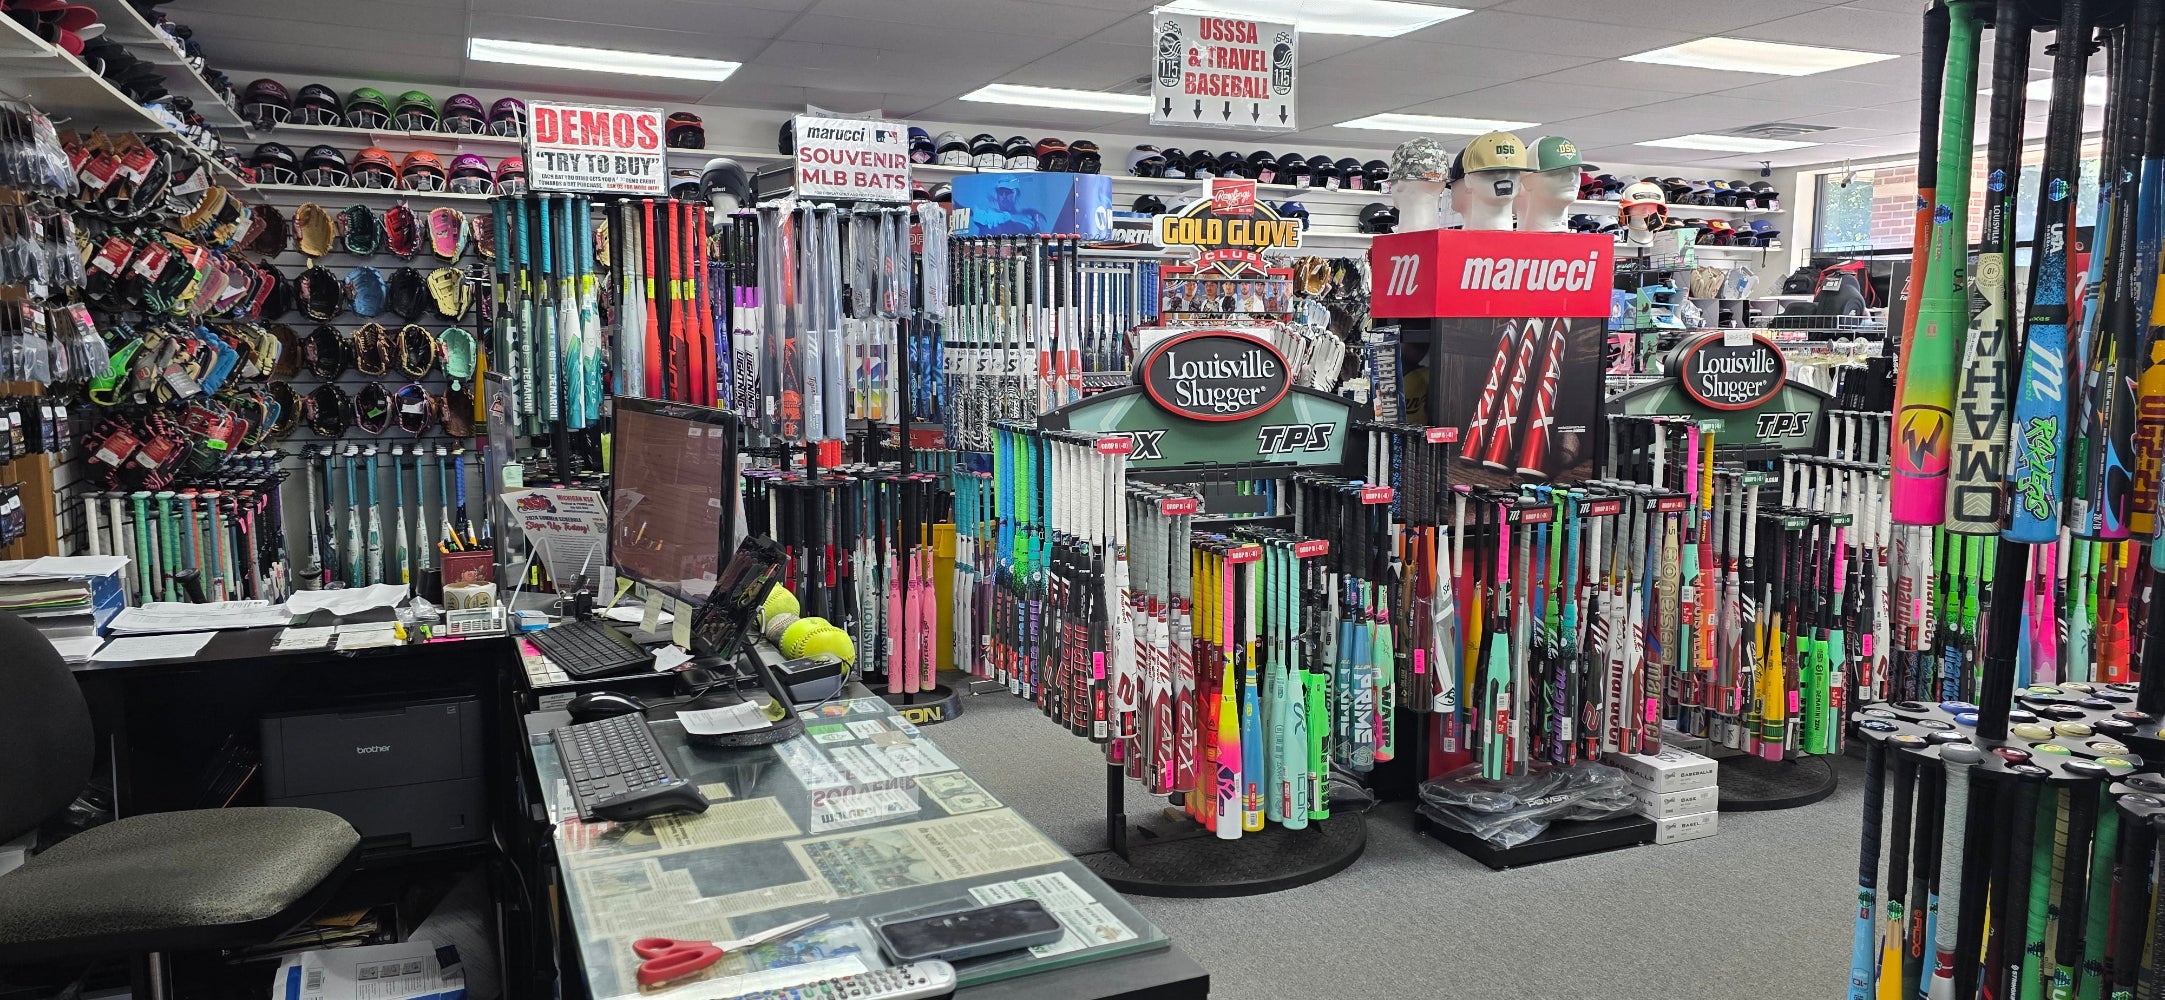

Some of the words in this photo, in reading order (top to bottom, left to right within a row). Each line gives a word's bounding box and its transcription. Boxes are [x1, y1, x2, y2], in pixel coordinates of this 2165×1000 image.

[1200, 17, 1258, 44] USSSA
[1187, 47, 1201, 67] &
[1207, 45, 1268, 72] TRAVEL
[1184, 71, 1269, 100] BASEBALL
[535, 107, 659, 150] DEMOS
[807, 126, 866, 142] marucci
[585, 153, 610, 174] TO
[799, 146, 907, 170] SOUVENIR
[1496, 145, 1515, 155] DSG
[802, 168, 848, 186] MLB
[854, 171, 906, 190] BATS
[1163, 217, 1223, 245] GOLD
[1227, 218, 1300, 248] GLOVE
[1991, 204, 2001, 245] LOUISVILLE
[1204, 250, 1257, 262] CLUB
[1459, 250, 1599, 292] marucci
[1167, 350, 1276, 380] Louisville
[1697, 348, 1775, 375] Louisville
[523, 367, 531, 412] DEMARINI
[550, 373, 558, 419] DEMARINI
[1175, 380, 1259, 413] Slugger
[1702, 374, 1763, 402] Slugger
[1257, 423, 1335, 454] TPS
[1756, 412, 1813, 437] TPS
[864, 607, 873, 669] LOUISVILLE
[1074, 625, 1088, 727] marucci
[1353, 673, 1373, 744] PRIME
[1381, 684, 1392, 748] WARP
[1814, 690, 1822, 718] DEMARINI
[356, 745, 391, 754] brother
[1297, 773, 1306, 821] ICON
